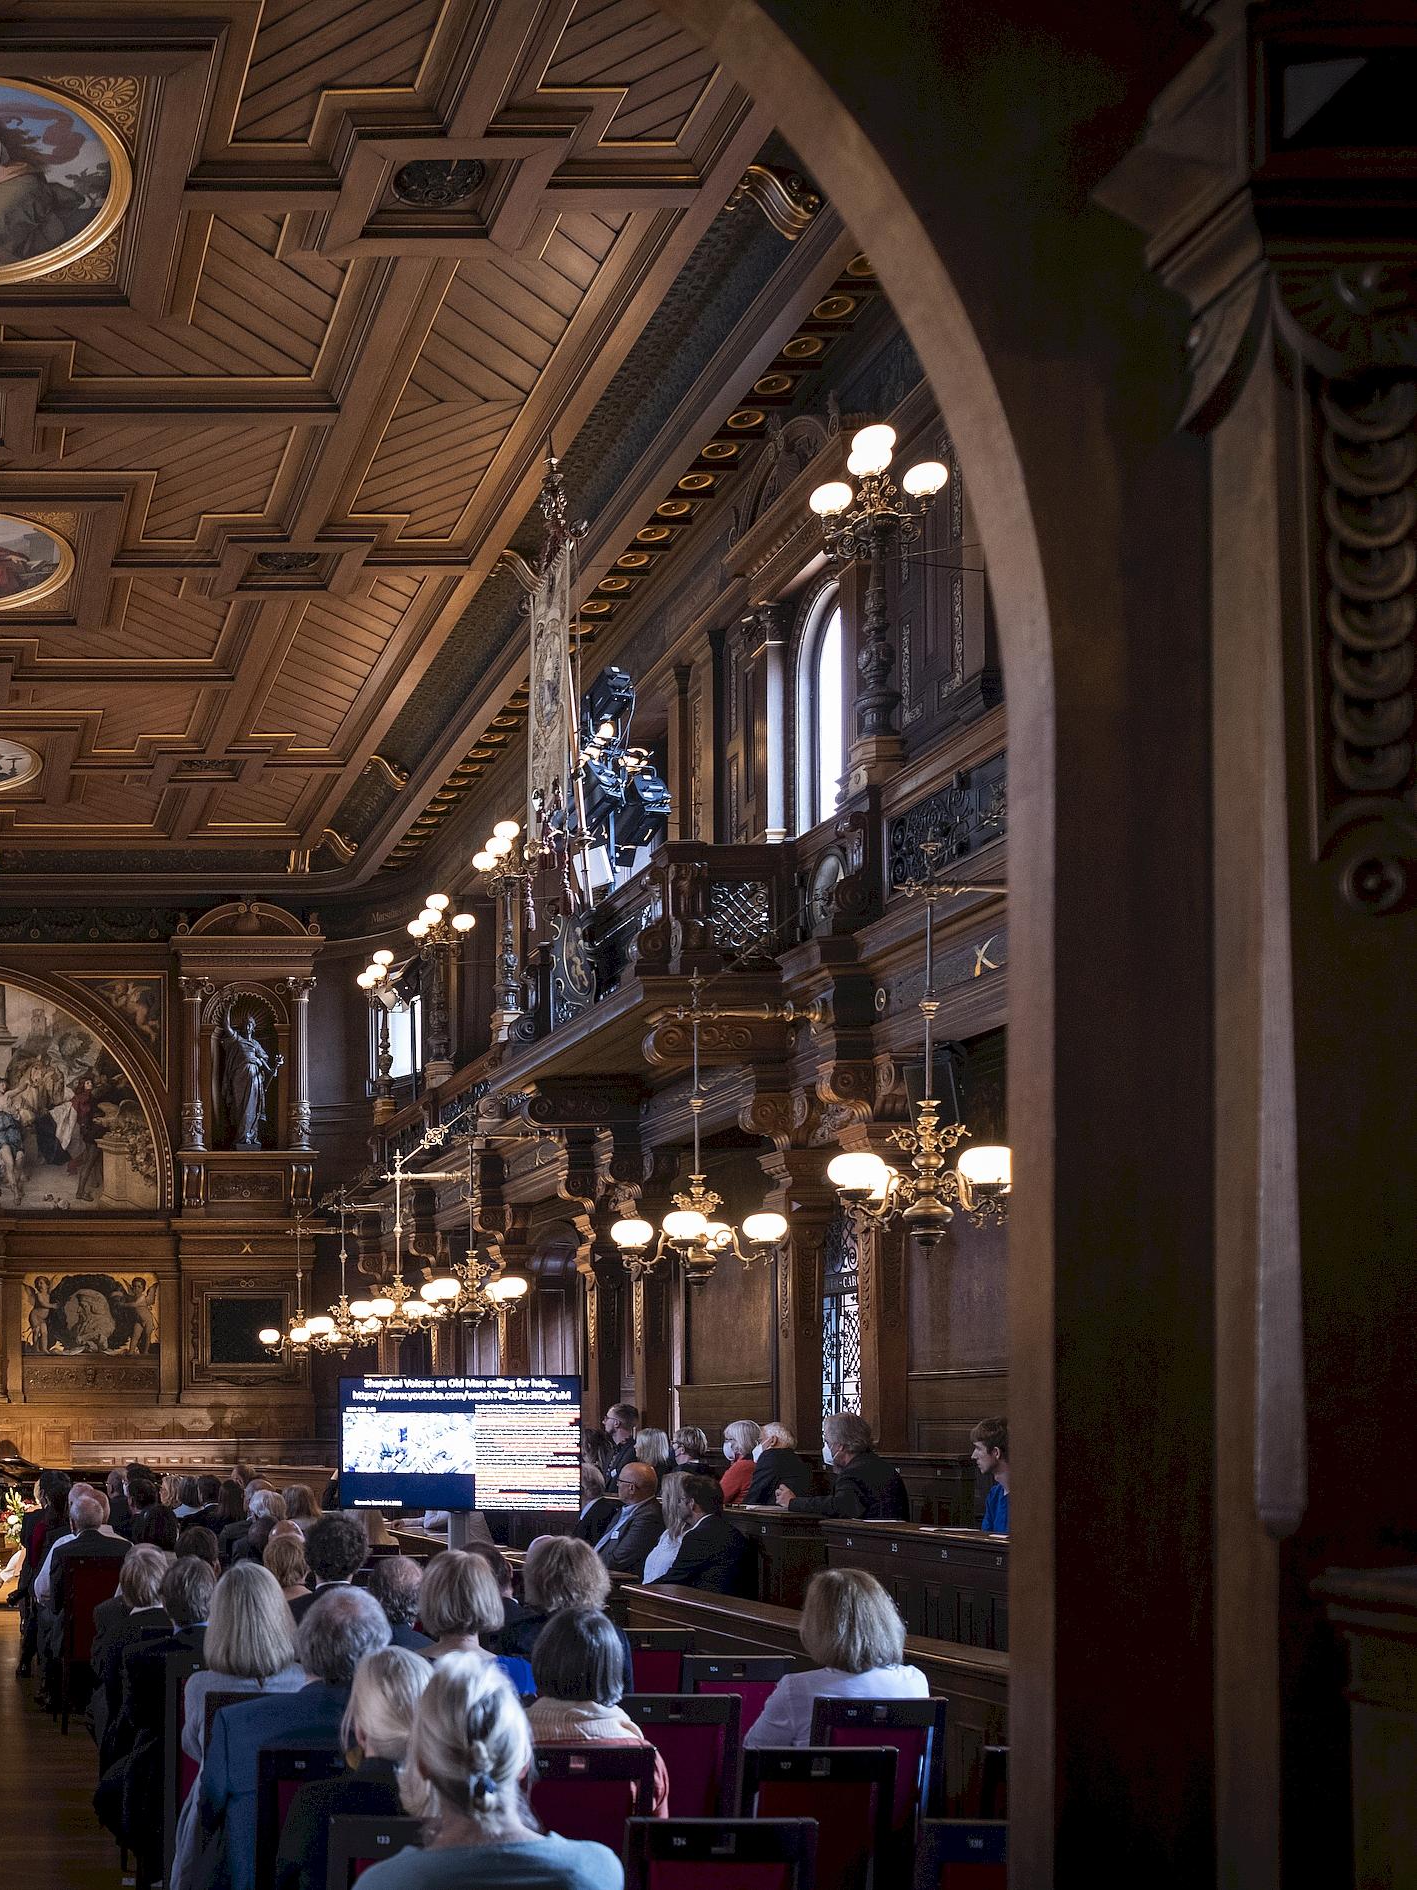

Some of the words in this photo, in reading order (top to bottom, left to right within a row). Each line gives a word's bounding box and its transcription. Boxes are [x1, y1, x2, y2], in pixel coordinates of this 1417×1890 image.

[363, 1378, 403, 1390] Shanghai
[435, 1380, 448, 1388] an
[448, 1378, 465, 1388] Old
[465, 1378, 486, 1388] Man
[486, 1378, 516, 1390] calling
[516, 1378, 530, 1388] for
